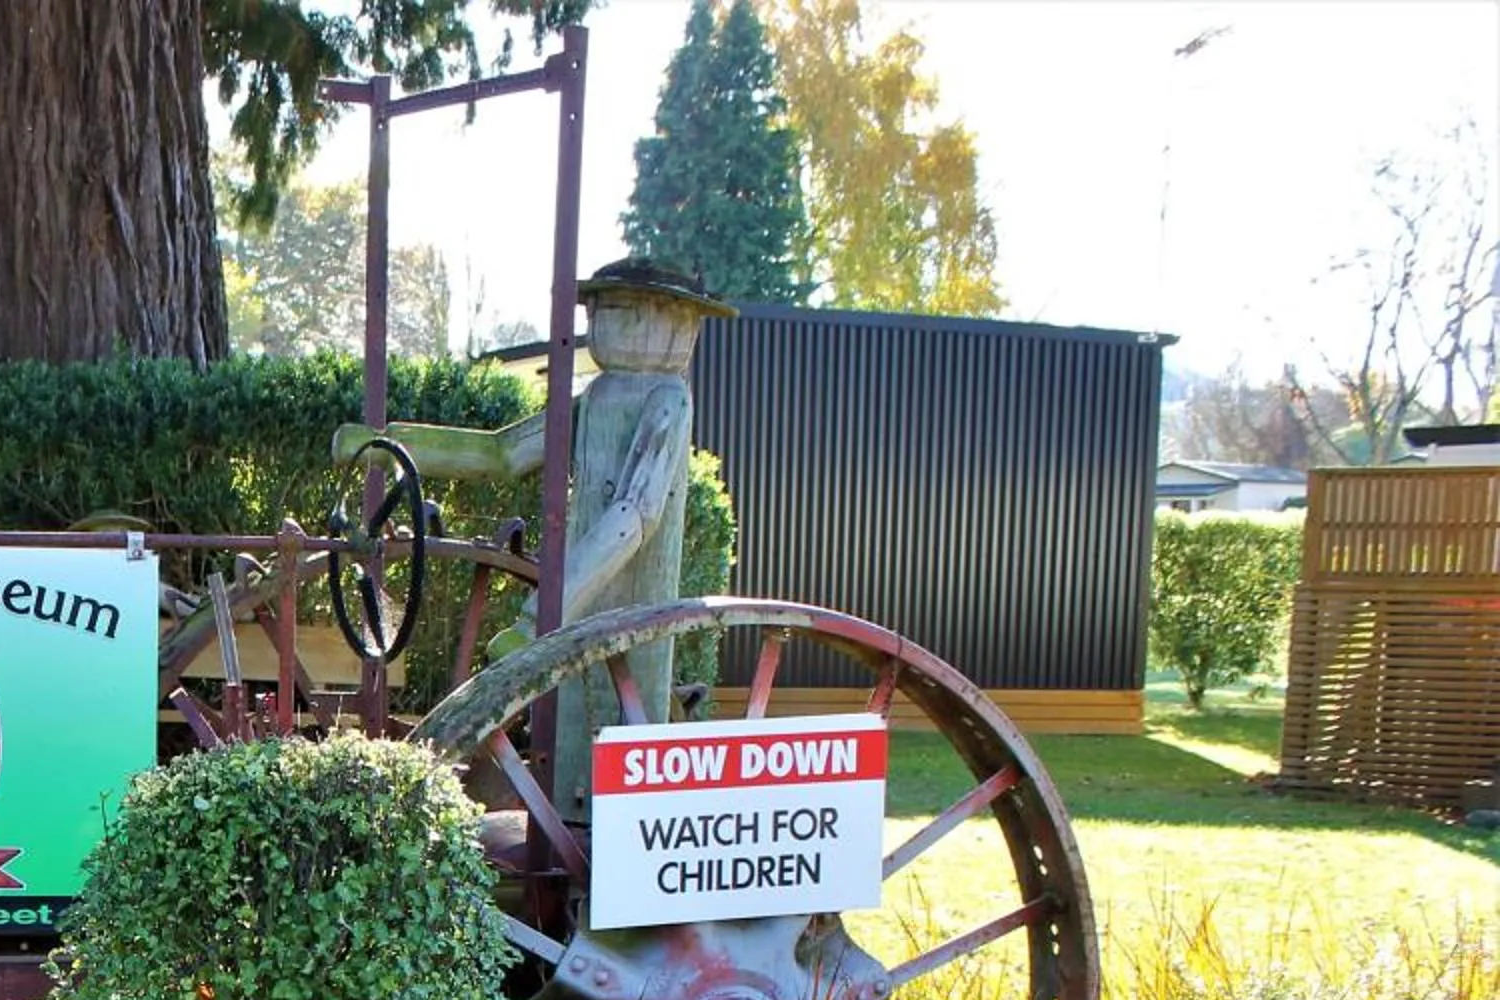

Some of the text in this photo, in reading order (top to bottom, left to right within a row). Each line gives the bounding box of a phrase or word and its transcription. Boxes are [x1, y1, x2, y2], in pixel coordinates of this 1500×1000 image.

[624, 739, 858, 786] SLOW DOWN
[639, 807, 839, 852] WATCH FOR
[657, 852, 821, 894] CHILDREN
